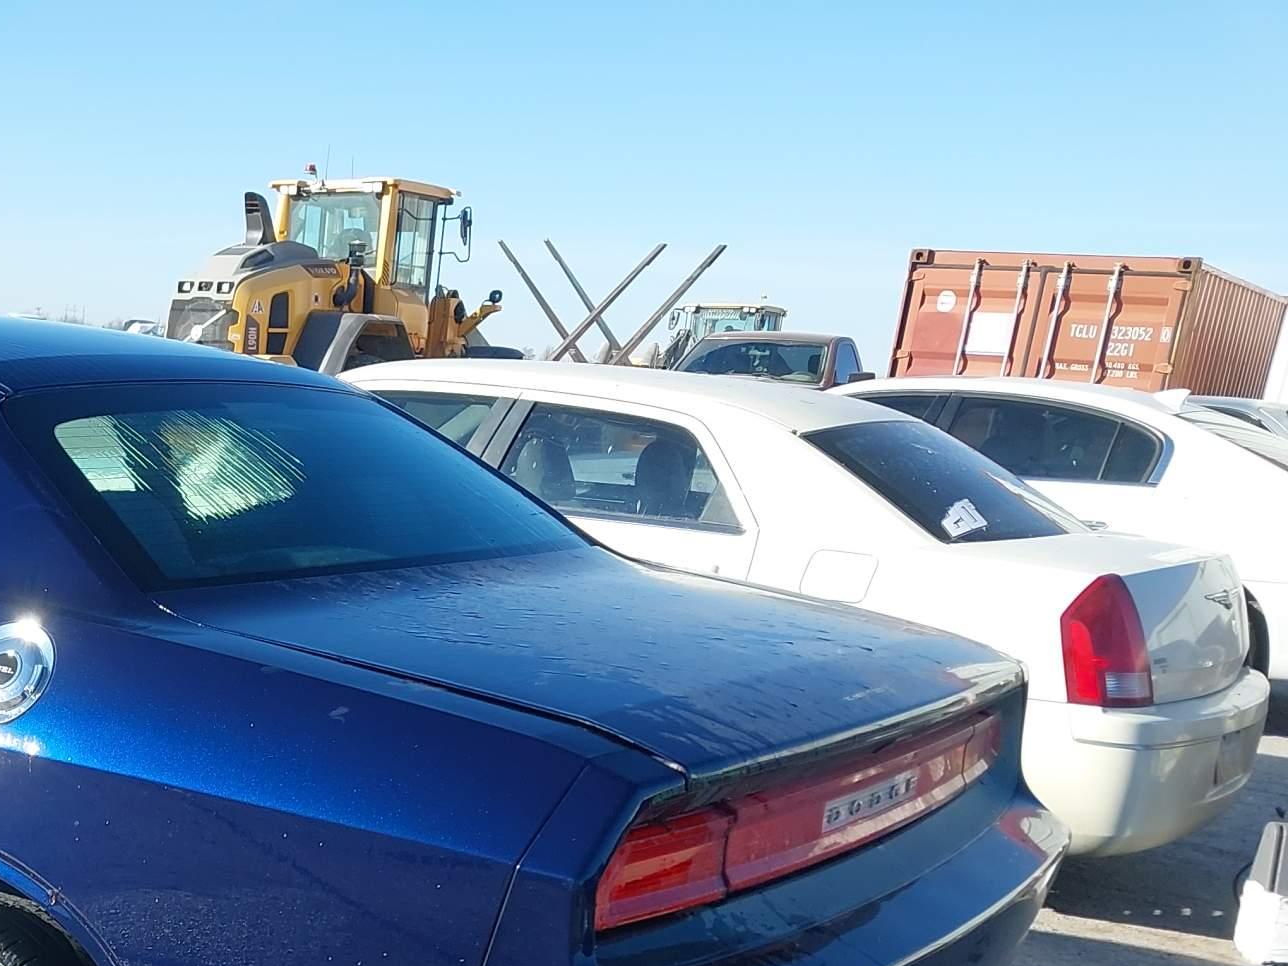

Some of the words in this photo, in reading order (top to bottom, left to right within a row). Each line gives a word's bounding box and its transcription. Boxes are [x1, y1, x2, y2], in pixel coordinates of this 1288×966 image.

[247, 326, 257, 350] L90H
[1070, 324, 1098, 338] TCLU
[1111, 326, 1154, 341] 323052
